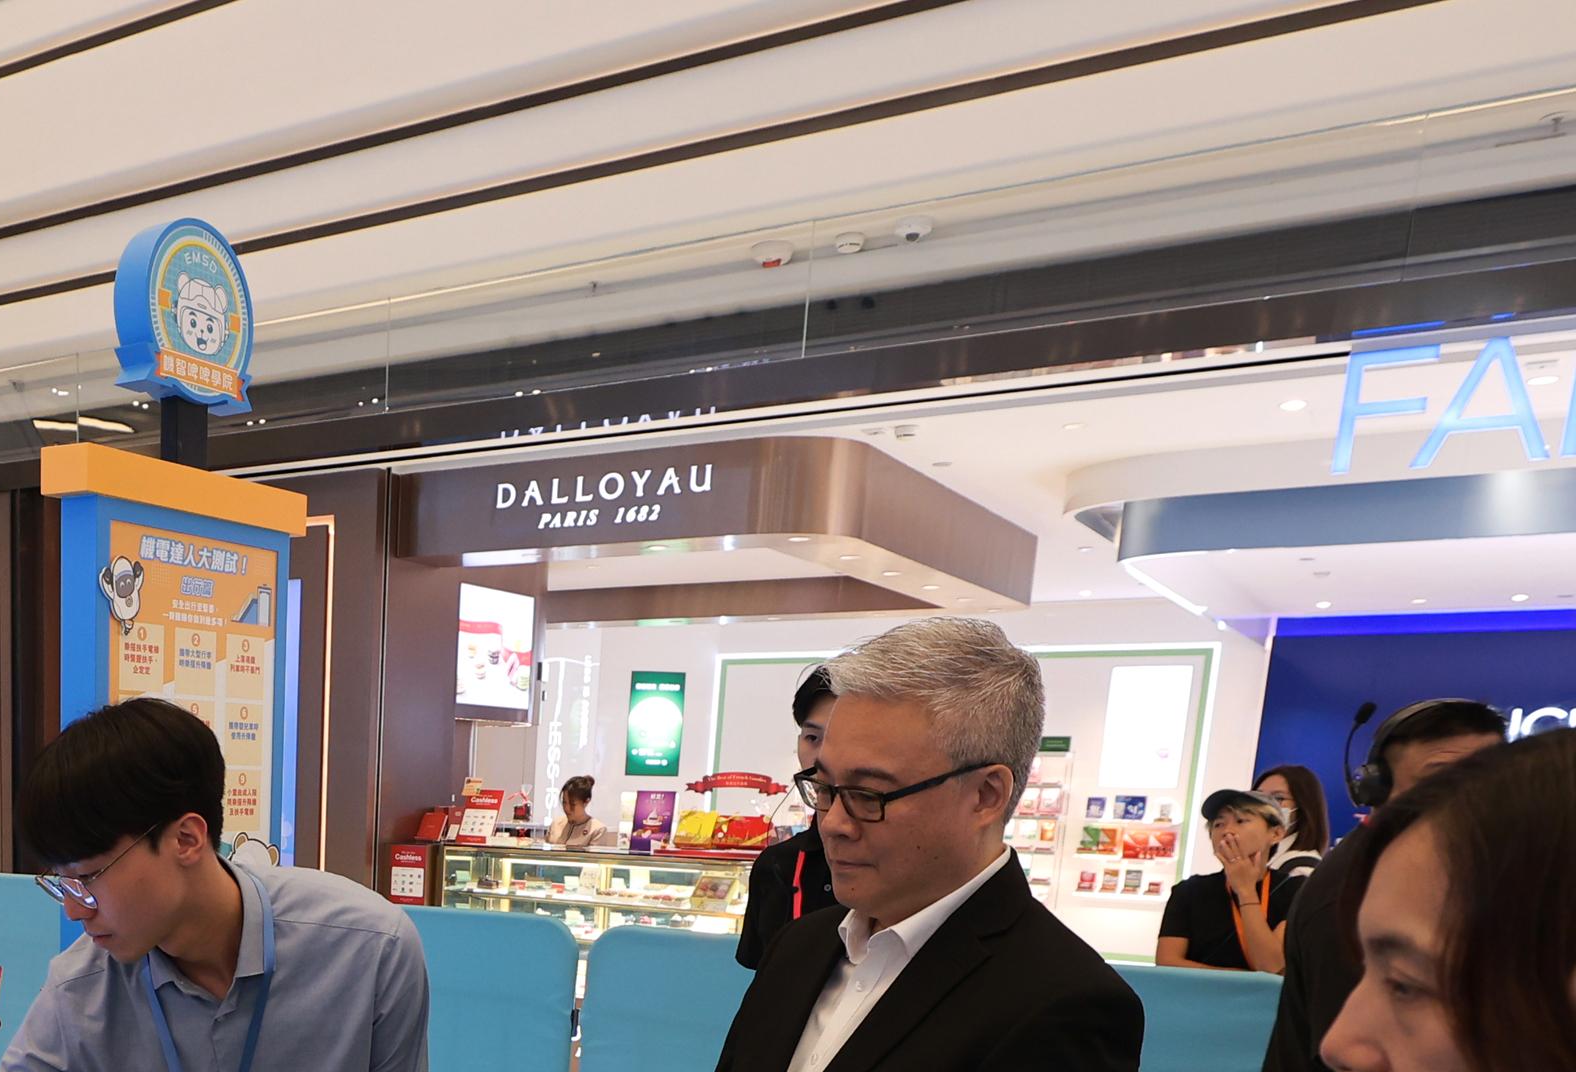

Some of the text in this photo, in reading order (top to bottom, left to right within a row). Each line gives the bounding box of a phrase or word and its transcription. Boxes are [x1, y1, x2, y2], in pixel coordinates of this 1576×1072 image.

[183, 251, 218, 274] EMSD
[496, 463, 713, 509] DALLOYAU
[537, 503, 661, 530] PARIS 1682
[140, 535, 248, 576] 機電達人大測試！
[470, 796, 499, 804] Cashless
[394, 853, 423, 862] Cashless
